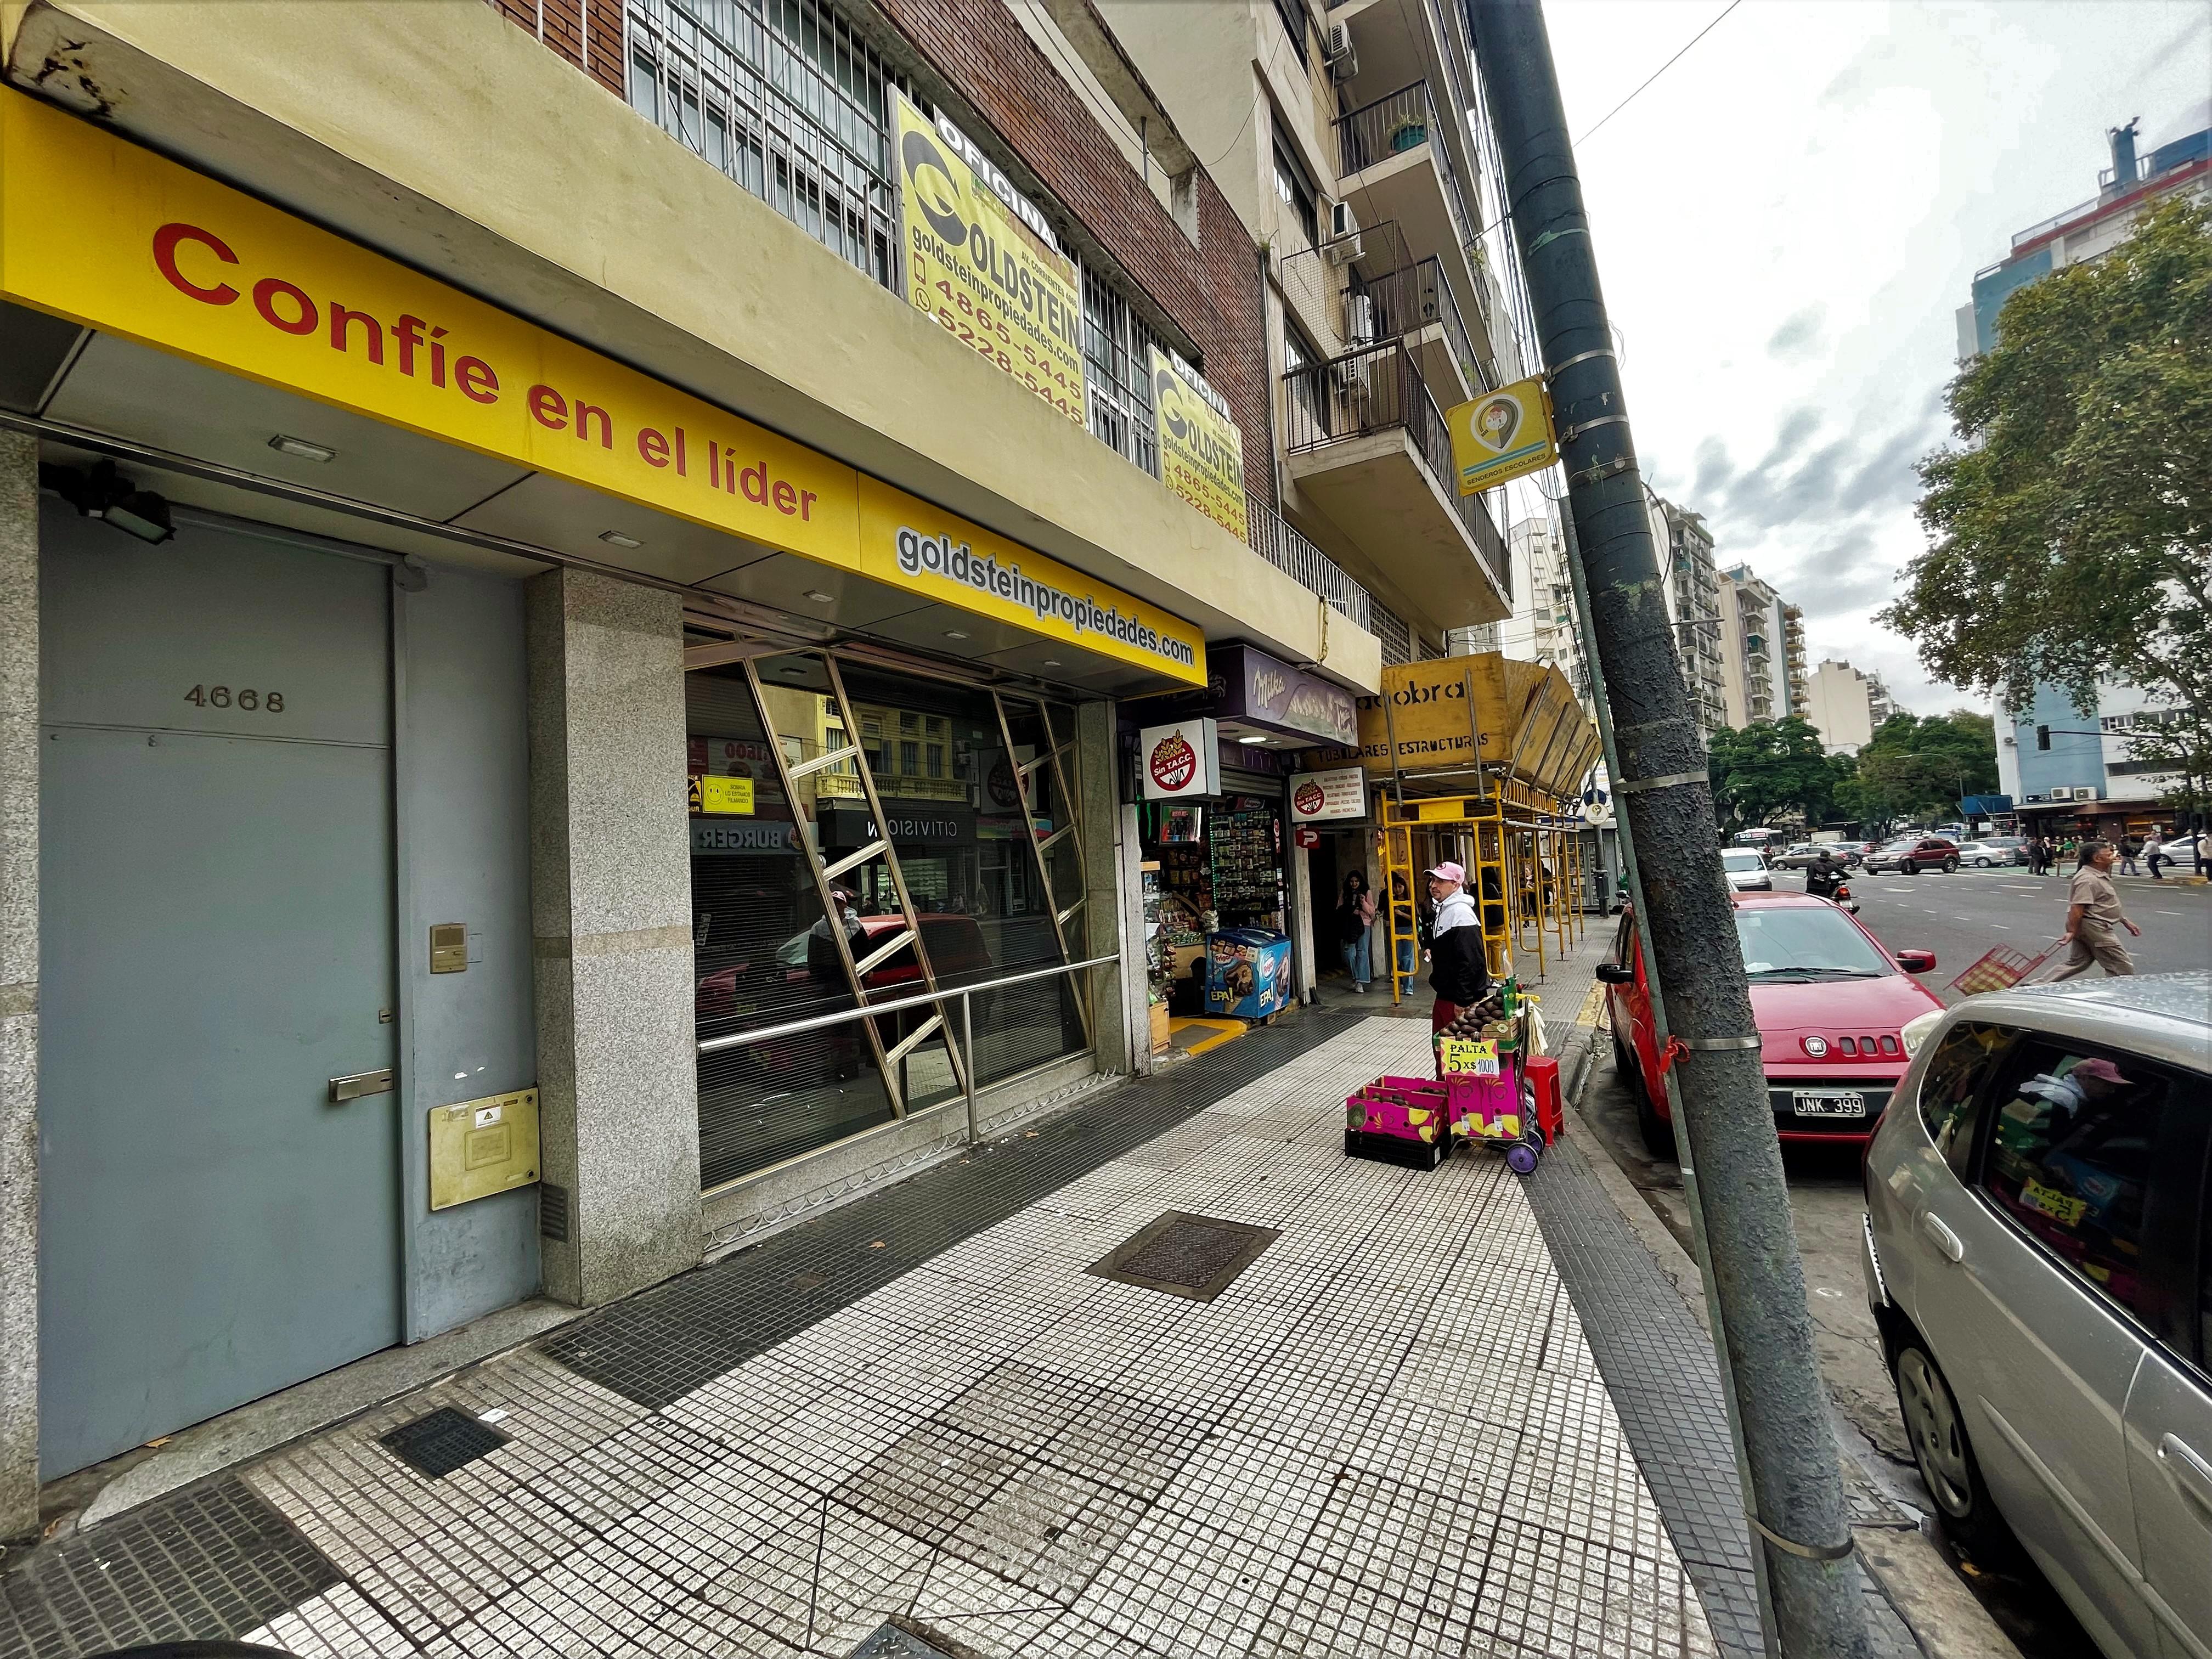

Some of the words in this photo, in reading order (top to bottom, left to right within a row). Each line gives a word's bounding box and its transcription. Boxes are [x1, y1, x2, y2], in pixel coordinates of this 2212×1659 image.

[939, 119, 1056, 251] OFICINA
[913, 225, 1079, 375] goldsteinpropiedades.com
[1022, 251, 1030, 265] AV.
[1031, 260, 1064, 297] CORRIENTES
[936, 280, 1081, 400] 4865-5445
[938, 307, 1083, 426] 5228-5445
[153, 223, 499, 404] Confíe
[529, 385, 612, 449] en
[637, 427, 686, 477] el
[709, 440, 817, 521] líder
[1173, 353, 1231, 424] OFICINA
[1163, 433, 1243, 507] goldsteinpropiedades.com
[1175, 465, 1244, 526] 4865-5445
[1467, 468, 1503, 485] SENDEROS
[1504, 453, 1546, 472] ESCOLARES
[1176, 484, 1246, 544] 5228-5445
[898, 528, 1194, 667] goldsteinpropiedades.com
[184, 685, 285, 713] 4668
[1253, 665, 1286, 710] Milka
[1154, 766, 1165, 776] Sin
[1211, 988, 1234, 1003] EPA!
[1260, 981, 1274, 1007] EPA!
[1449, 1053, 1462, 1073] 5
[1450, 1045, 1487, 1054] PALTA
[1798, 1098, 1825, 1112] JNK
[1833, 1098, 1862, 1113] 399
